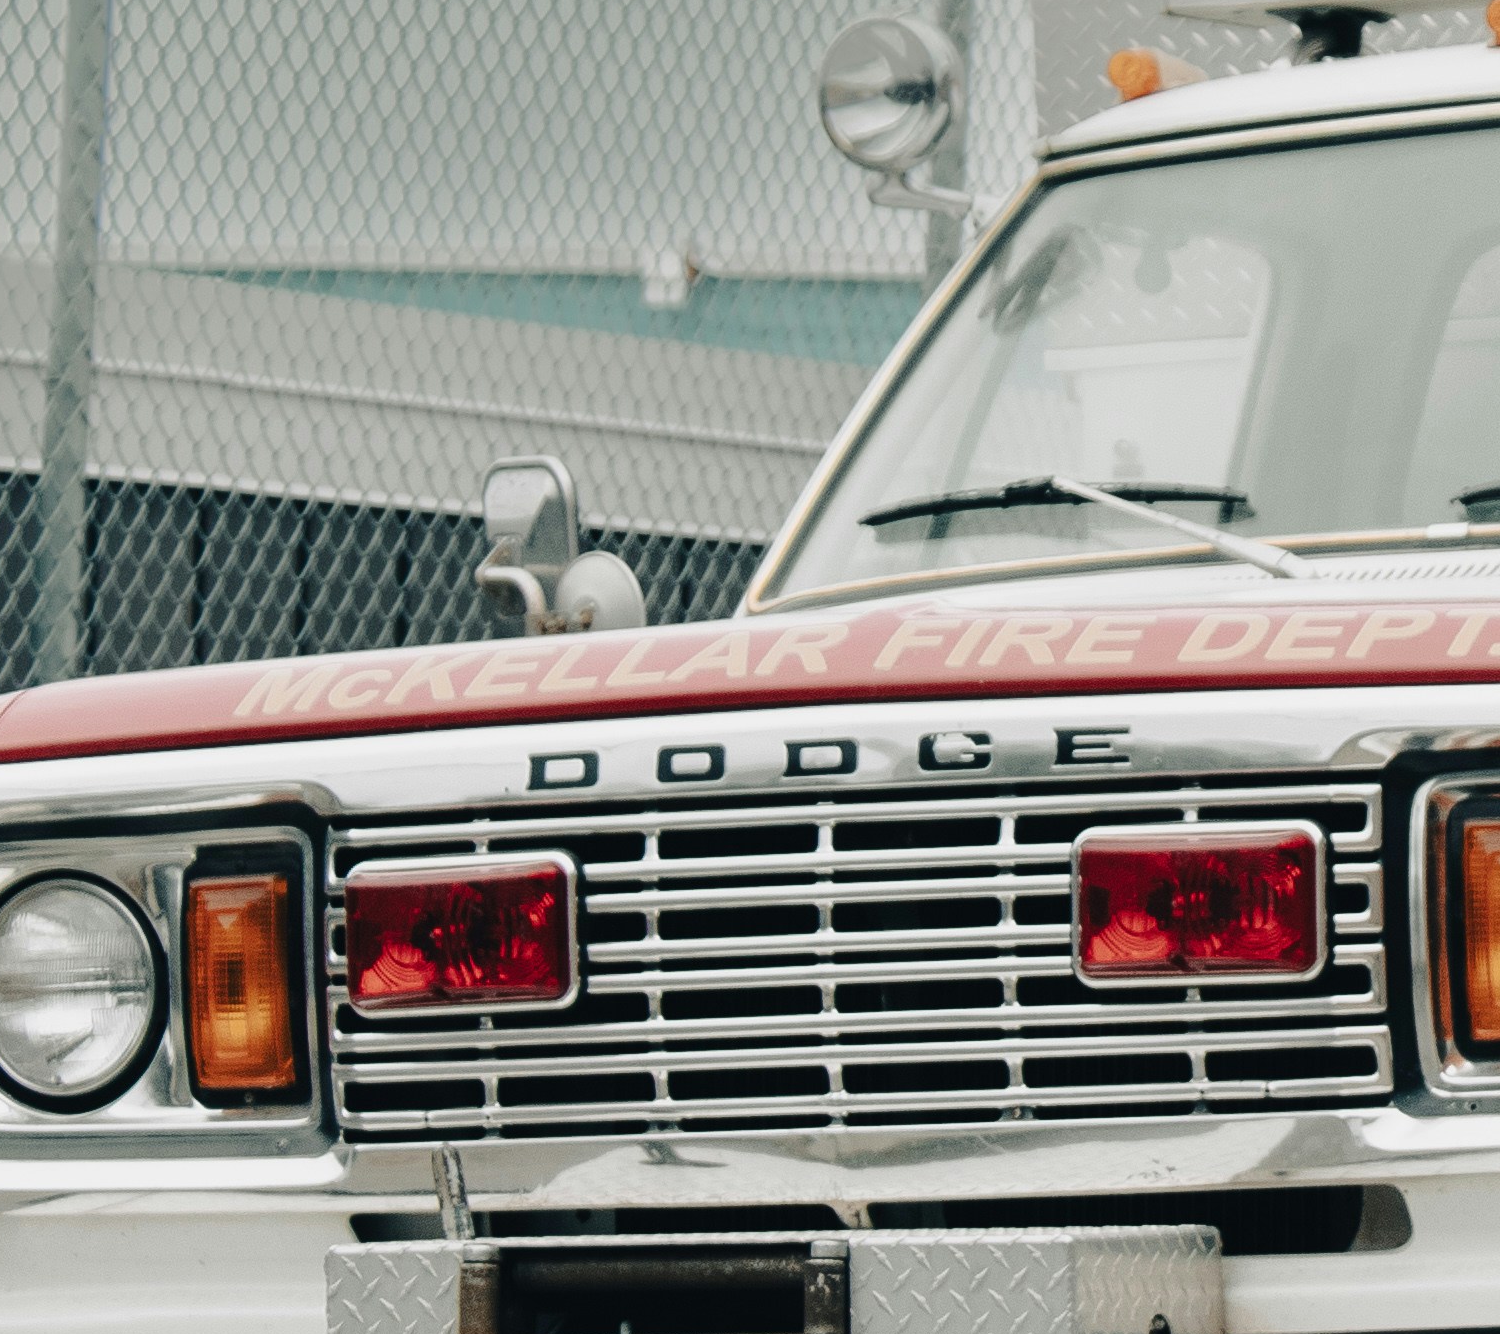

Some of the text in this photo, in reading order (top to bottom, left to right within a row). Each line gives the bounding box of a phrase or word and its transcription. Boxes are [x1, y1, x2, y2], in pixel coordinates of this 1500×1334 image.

[233, 622, 850, 717] McKELLAR
[872, 614, 1158, 668] FIRE
[526, 725, 1132, 792] DODGE
